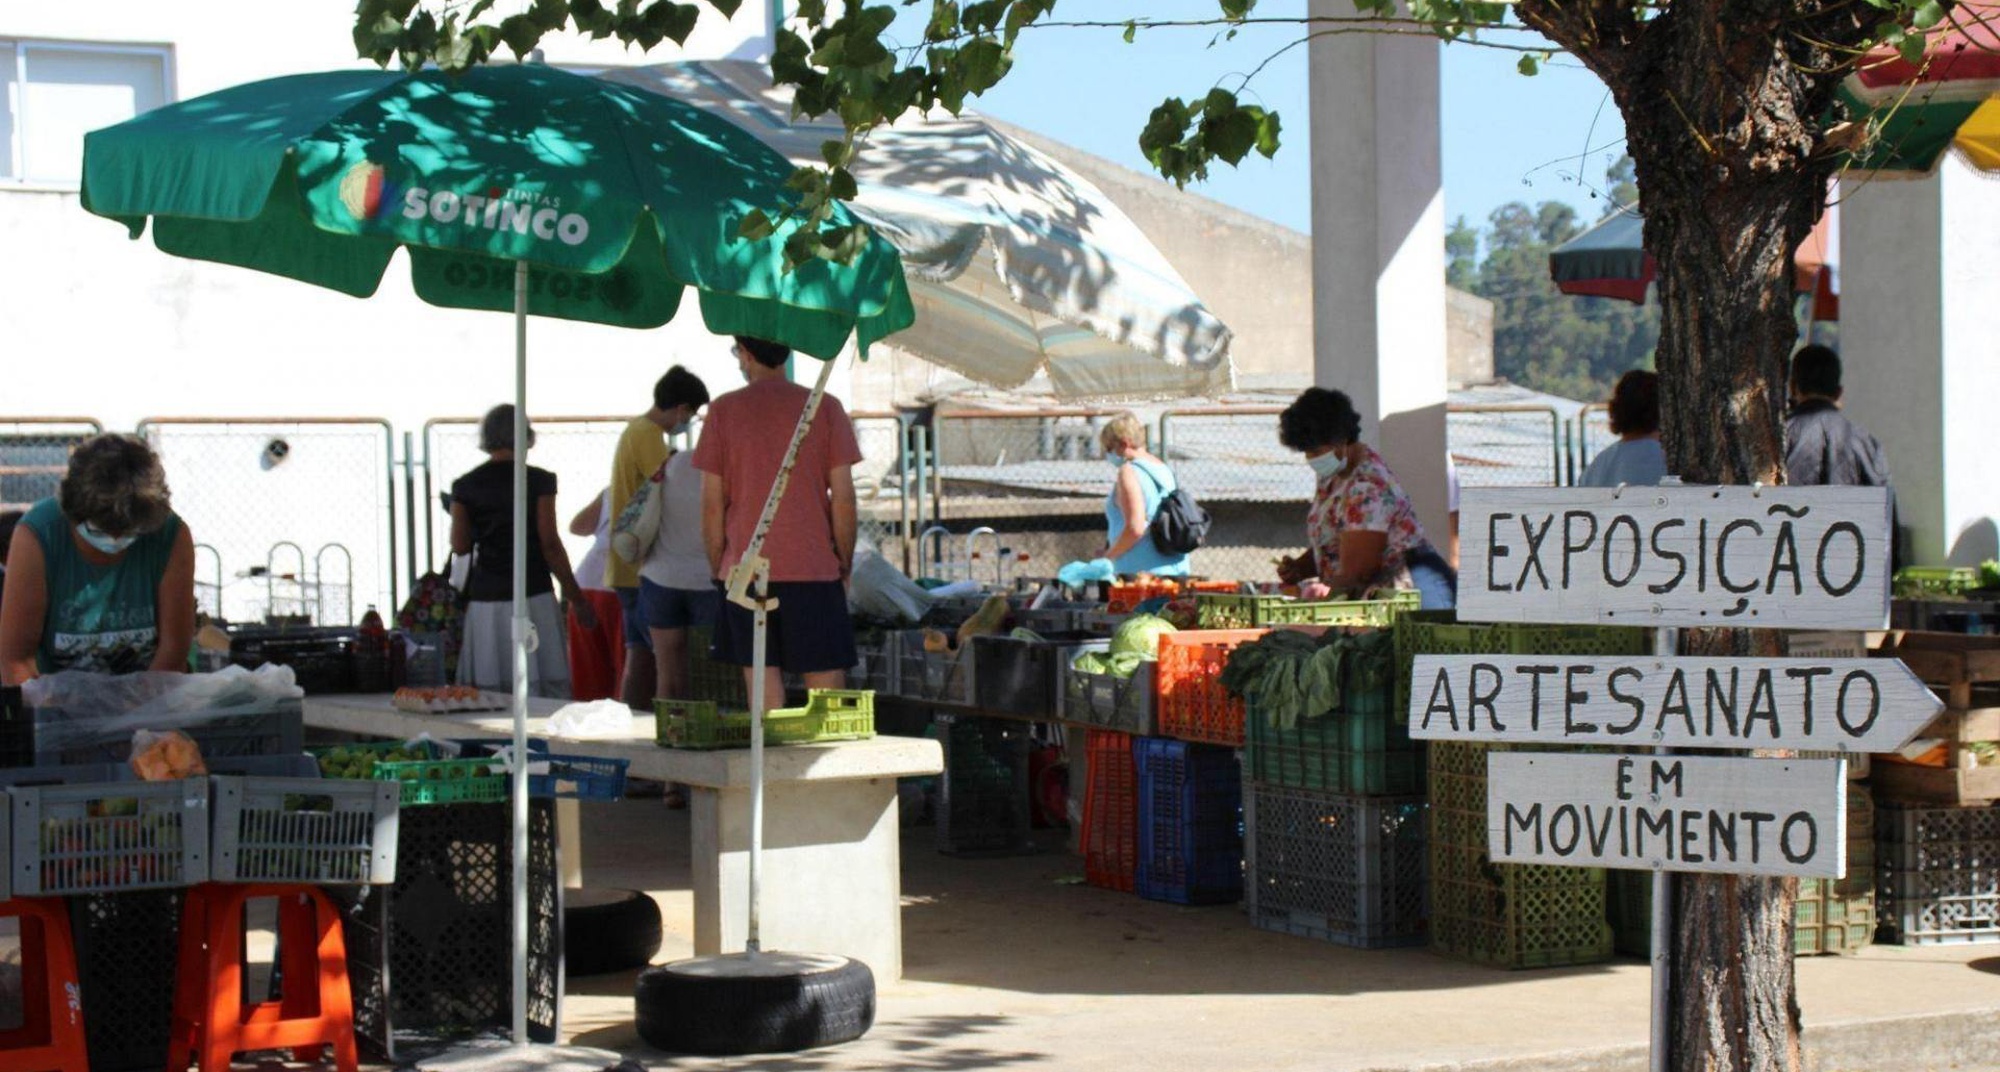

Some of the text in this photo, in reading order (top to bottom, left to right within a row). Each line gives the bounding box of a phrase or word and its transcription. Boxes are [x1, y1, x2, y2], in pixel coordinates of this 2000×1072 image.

[403, 187, 589, 245] SOTINCO
[505, 188, 562, 208] TINTAS
[1487, 504, 1866, 617] EXPOSIÇÃO
[1421, 663, 1881, 738] ARTESANATO
[1616, 757, 1684, 801] EM
[1504, 803, 1818, 865] MOVIMENTO
